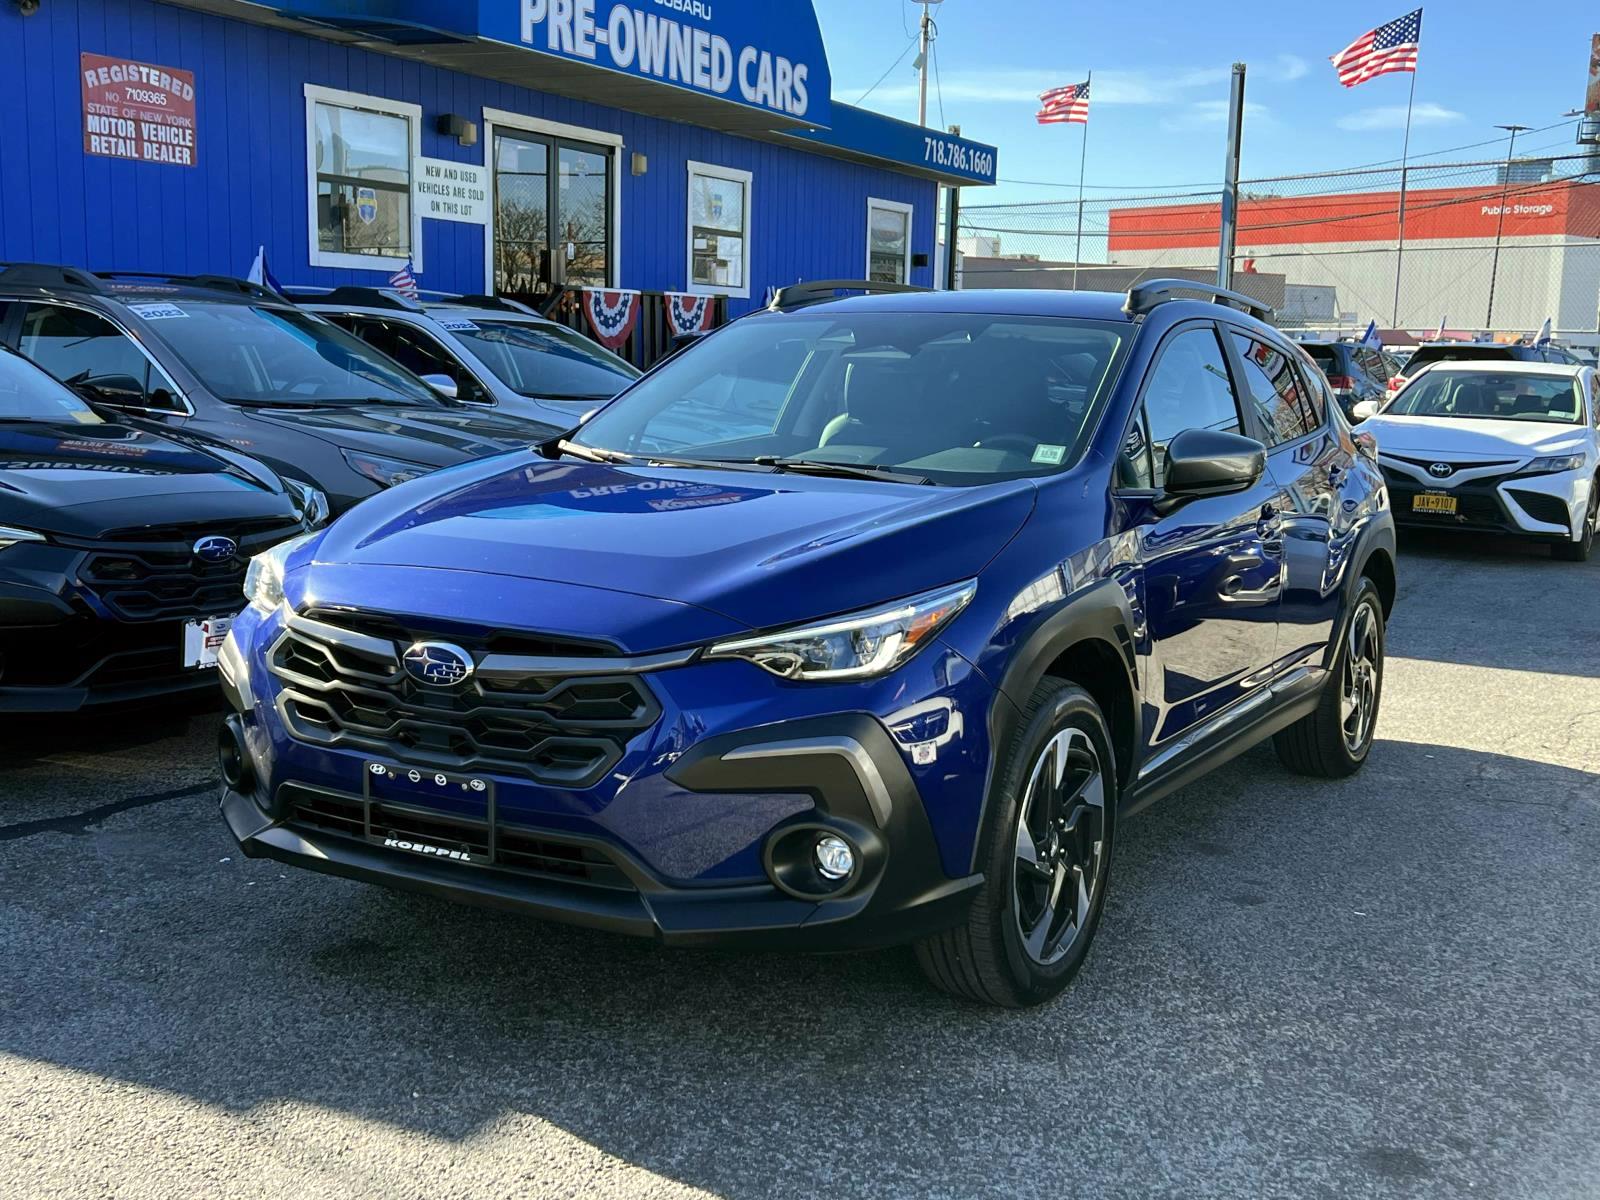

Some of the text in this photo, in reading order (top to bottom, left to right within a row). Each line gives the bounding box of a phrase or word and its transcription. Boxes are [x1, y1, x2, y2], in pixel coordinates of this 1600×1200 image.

[654, 0, 711, 20] UBARU
[520, 0, 808, 117] PRE-OWNED CARS
[85, 64, 194, 101] REGISTERED
[125, 87, 167, 106] 7109365
[87, 103, 192, 127] STATE OF NEW YORK
[87, 114, 193, 147] MOTOR VEHICLE
[90, 135, 191, 165] RETAIL DEALER
[925, 137, 992, 176] 718.786.1660
[425, 165, 477, 183] NEW AND USED
[418, 182, 484, 201] VEHICLES ARE SOLD
[431, 201, 472, 216] ON THIS LOT
[1481, 204, 1553, 215] Pubic Storage
[384, 838, 471, 861] KOEPPEL
